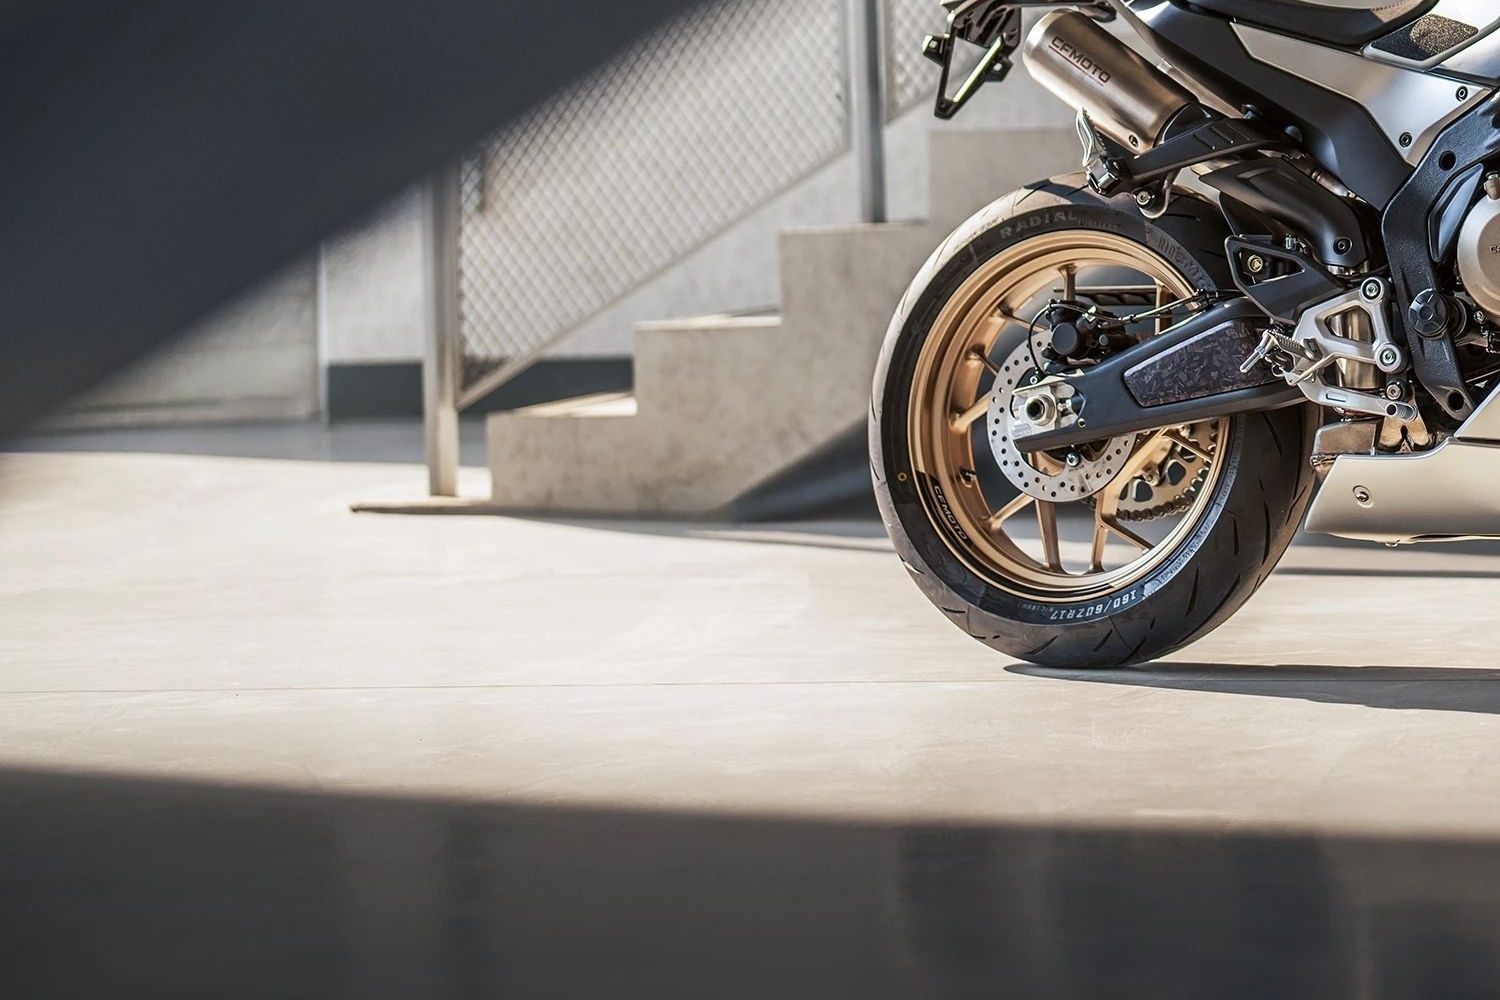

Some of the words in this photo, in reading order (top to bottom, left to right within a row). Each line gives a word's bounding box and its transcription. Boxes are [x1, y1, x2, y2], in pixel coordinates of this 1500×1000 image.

[1051, 36, 1111, 83] CFMOTO
[1000, 211, 1078, 239] RADIAL
[934, 485, 968, 540] CFMOTO
[1050, 589, 1137, 620] 160/60ZR17
